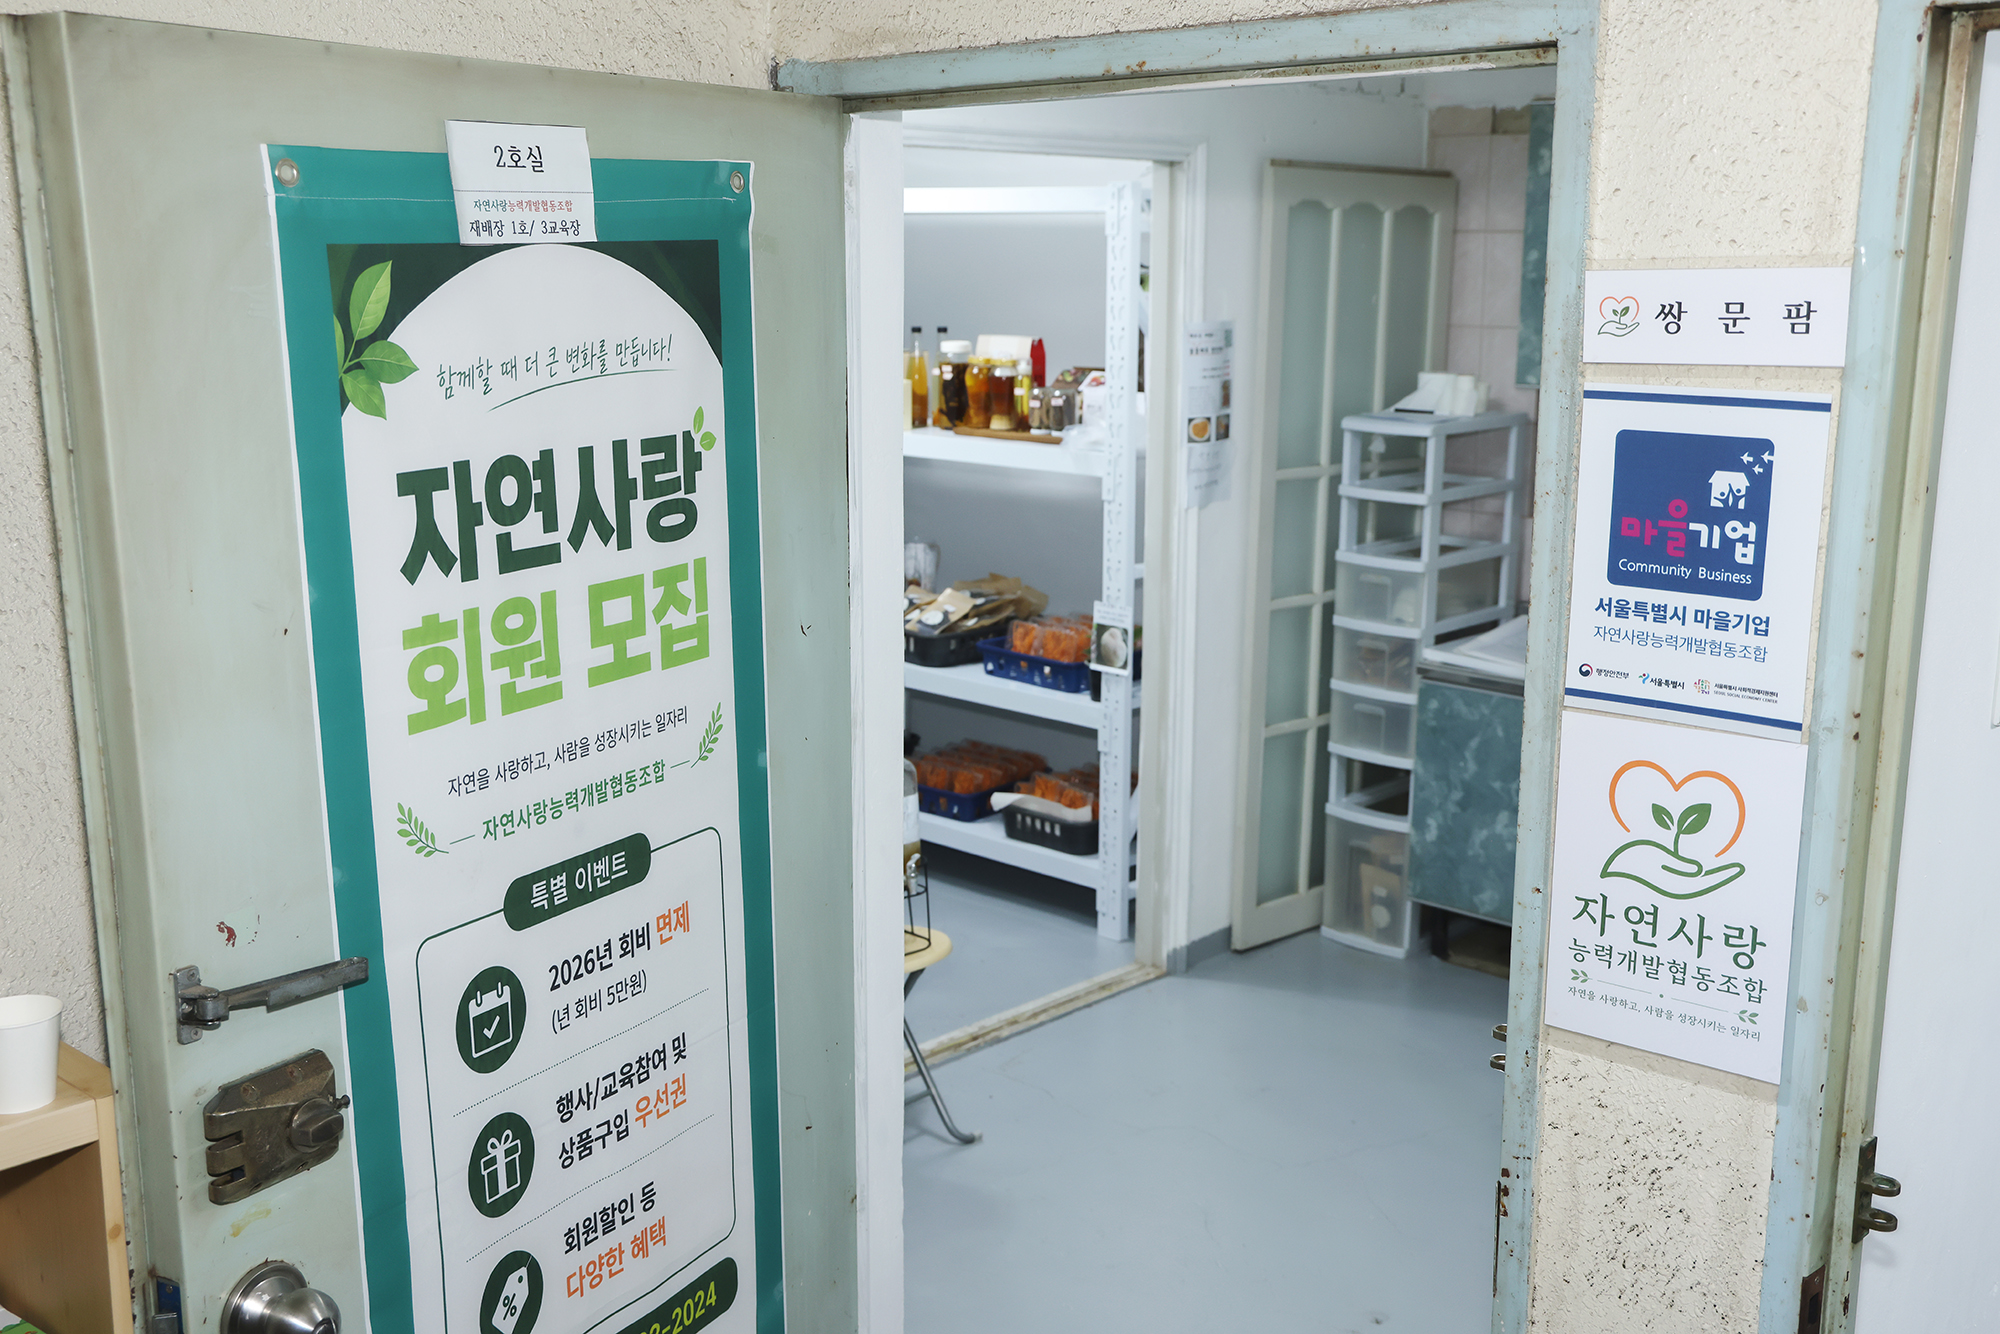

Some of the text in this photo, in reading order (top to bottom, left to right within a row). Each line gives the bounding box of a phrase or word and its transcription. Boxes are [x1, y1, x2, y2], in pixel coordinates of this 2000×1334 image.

[493, 145, 545, 173] 2호실
[469, 219, 505, 237] 재배장
[541, 219, 581, 237] 3교육장
[473, 199, 573, 213] 자연사랑능력개발협동조합
[436, 334, 673, 400] 함께할 때 더 큰 변화를 만듭니다!
[396, 429, 702, 586] 자연사랑
[1620, 498, 1757, 565] 마을기업
[1618, 558, 1752, 585] Community Business
[402, 556, 710, 736] 회원 모집
[1593, 625, 1768, 663] 자연사랑능력개발협동조합
[1594, 596, 1771, 637] 서울특별시 마을기업
[1649, 677, 1685, 690] 서울특별시
[448, 705, 688, 797] 자연을 사랑하고, 사람을 성장시키는 일자리
[482, 759, 666, 841] 자연사랑능력개발협동조합
[530, 851, 629, 910] 특별 이벤트
[548, 900, 690, 992] 2026년 회비 면제
[1572, 892, 1767, 970] 자연사랑
[551, 969, 648, 1035] (년 회비 5만원)
[1568, 937, 1767, 1005] 능력개발협동조합
[1567, 985, 1761, 1043] 자연을 사랑하고, 사람을 성장시키는 일자리
[556, 1032, 687, 1124] 행사/교육참여 및
[558, 1073, 687, 1170] 상품구입 우선권
[563, 1181, 657, 1255] 회원할인 등
[565, 1215, 667, 1299] 다양한 혜택
